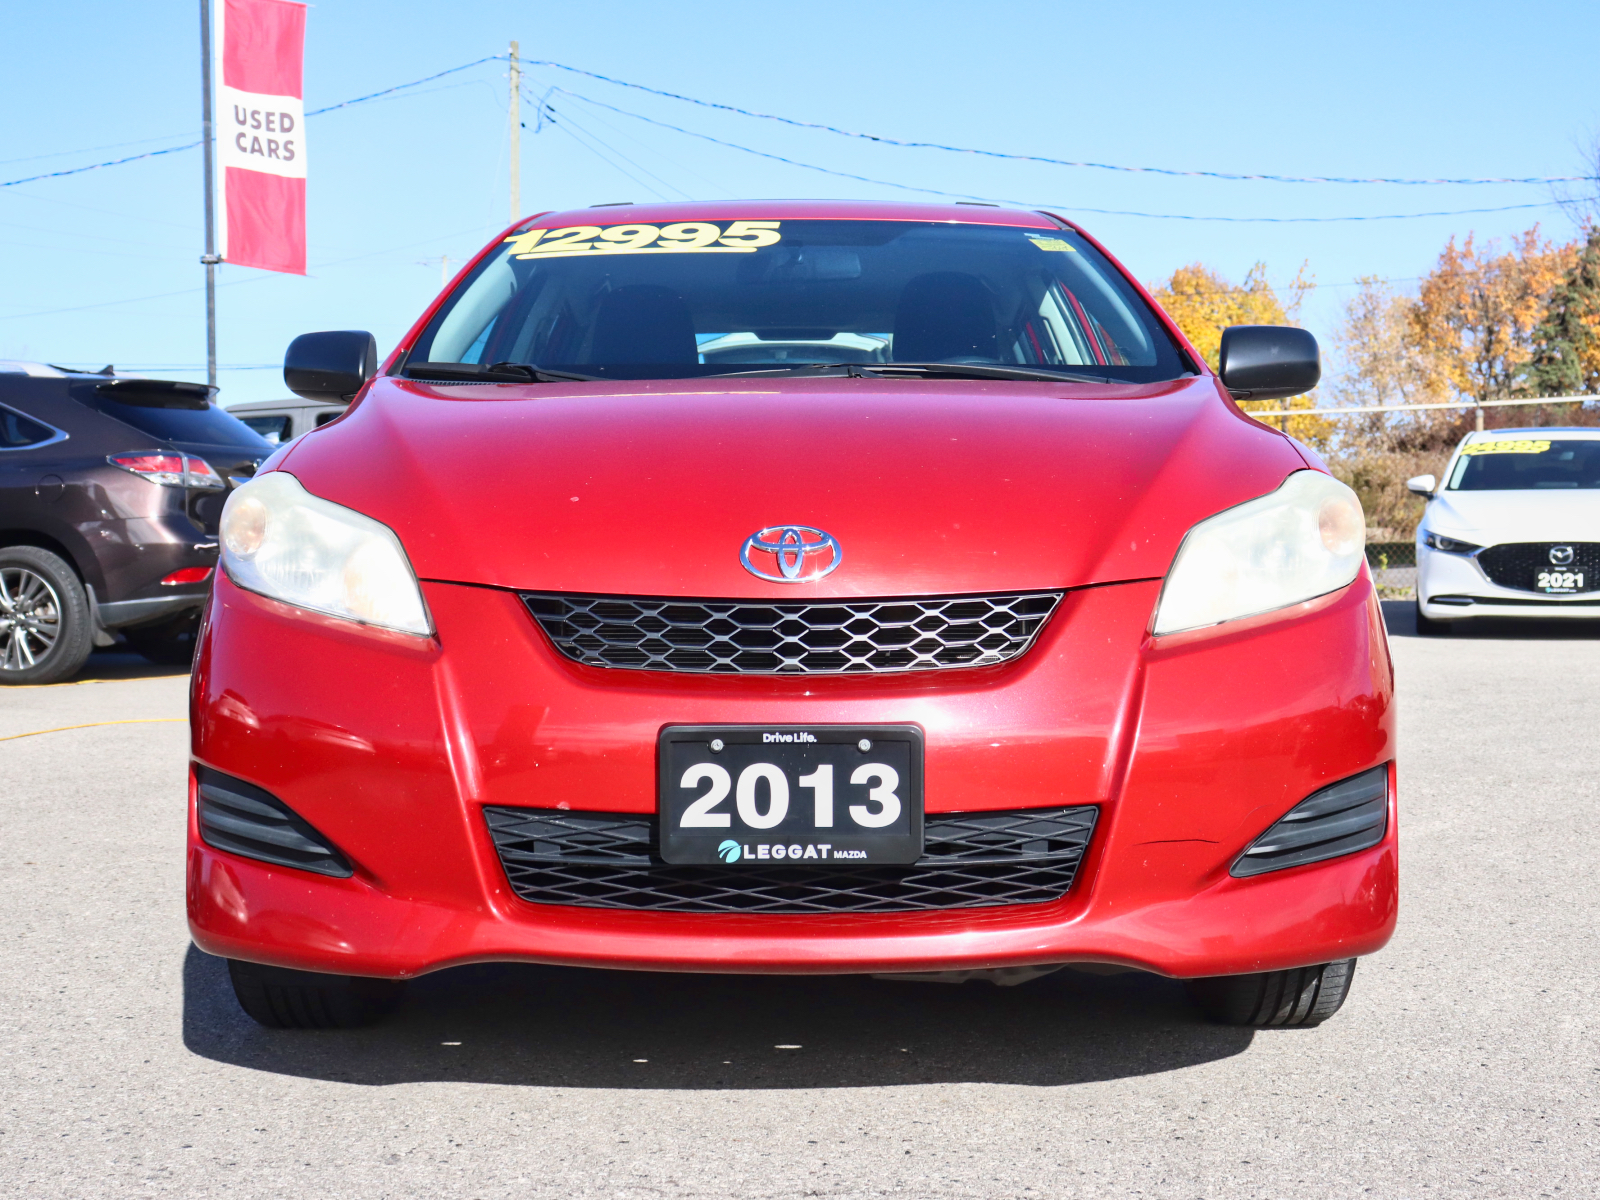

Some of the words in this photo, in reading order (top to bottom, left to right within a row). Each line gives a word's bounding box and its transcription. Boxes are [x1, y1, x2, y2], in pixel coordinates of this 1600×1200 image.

[234, 104, 295, 134] USED
[235, 132, 296, 162] CARS
[503, 221, 781, 255] 12995
[1460, 440, 1552, 455] 24995
[1537, 572, 1584, 588] 2021
[762, 732, 793, 743] Drive
[793, 732, 818, 743] Life.
[679, 762, 902, 829] 2013
[743, 844, 832, 859] LEGGAT
[833, 850, 868, 859] MAZDA
